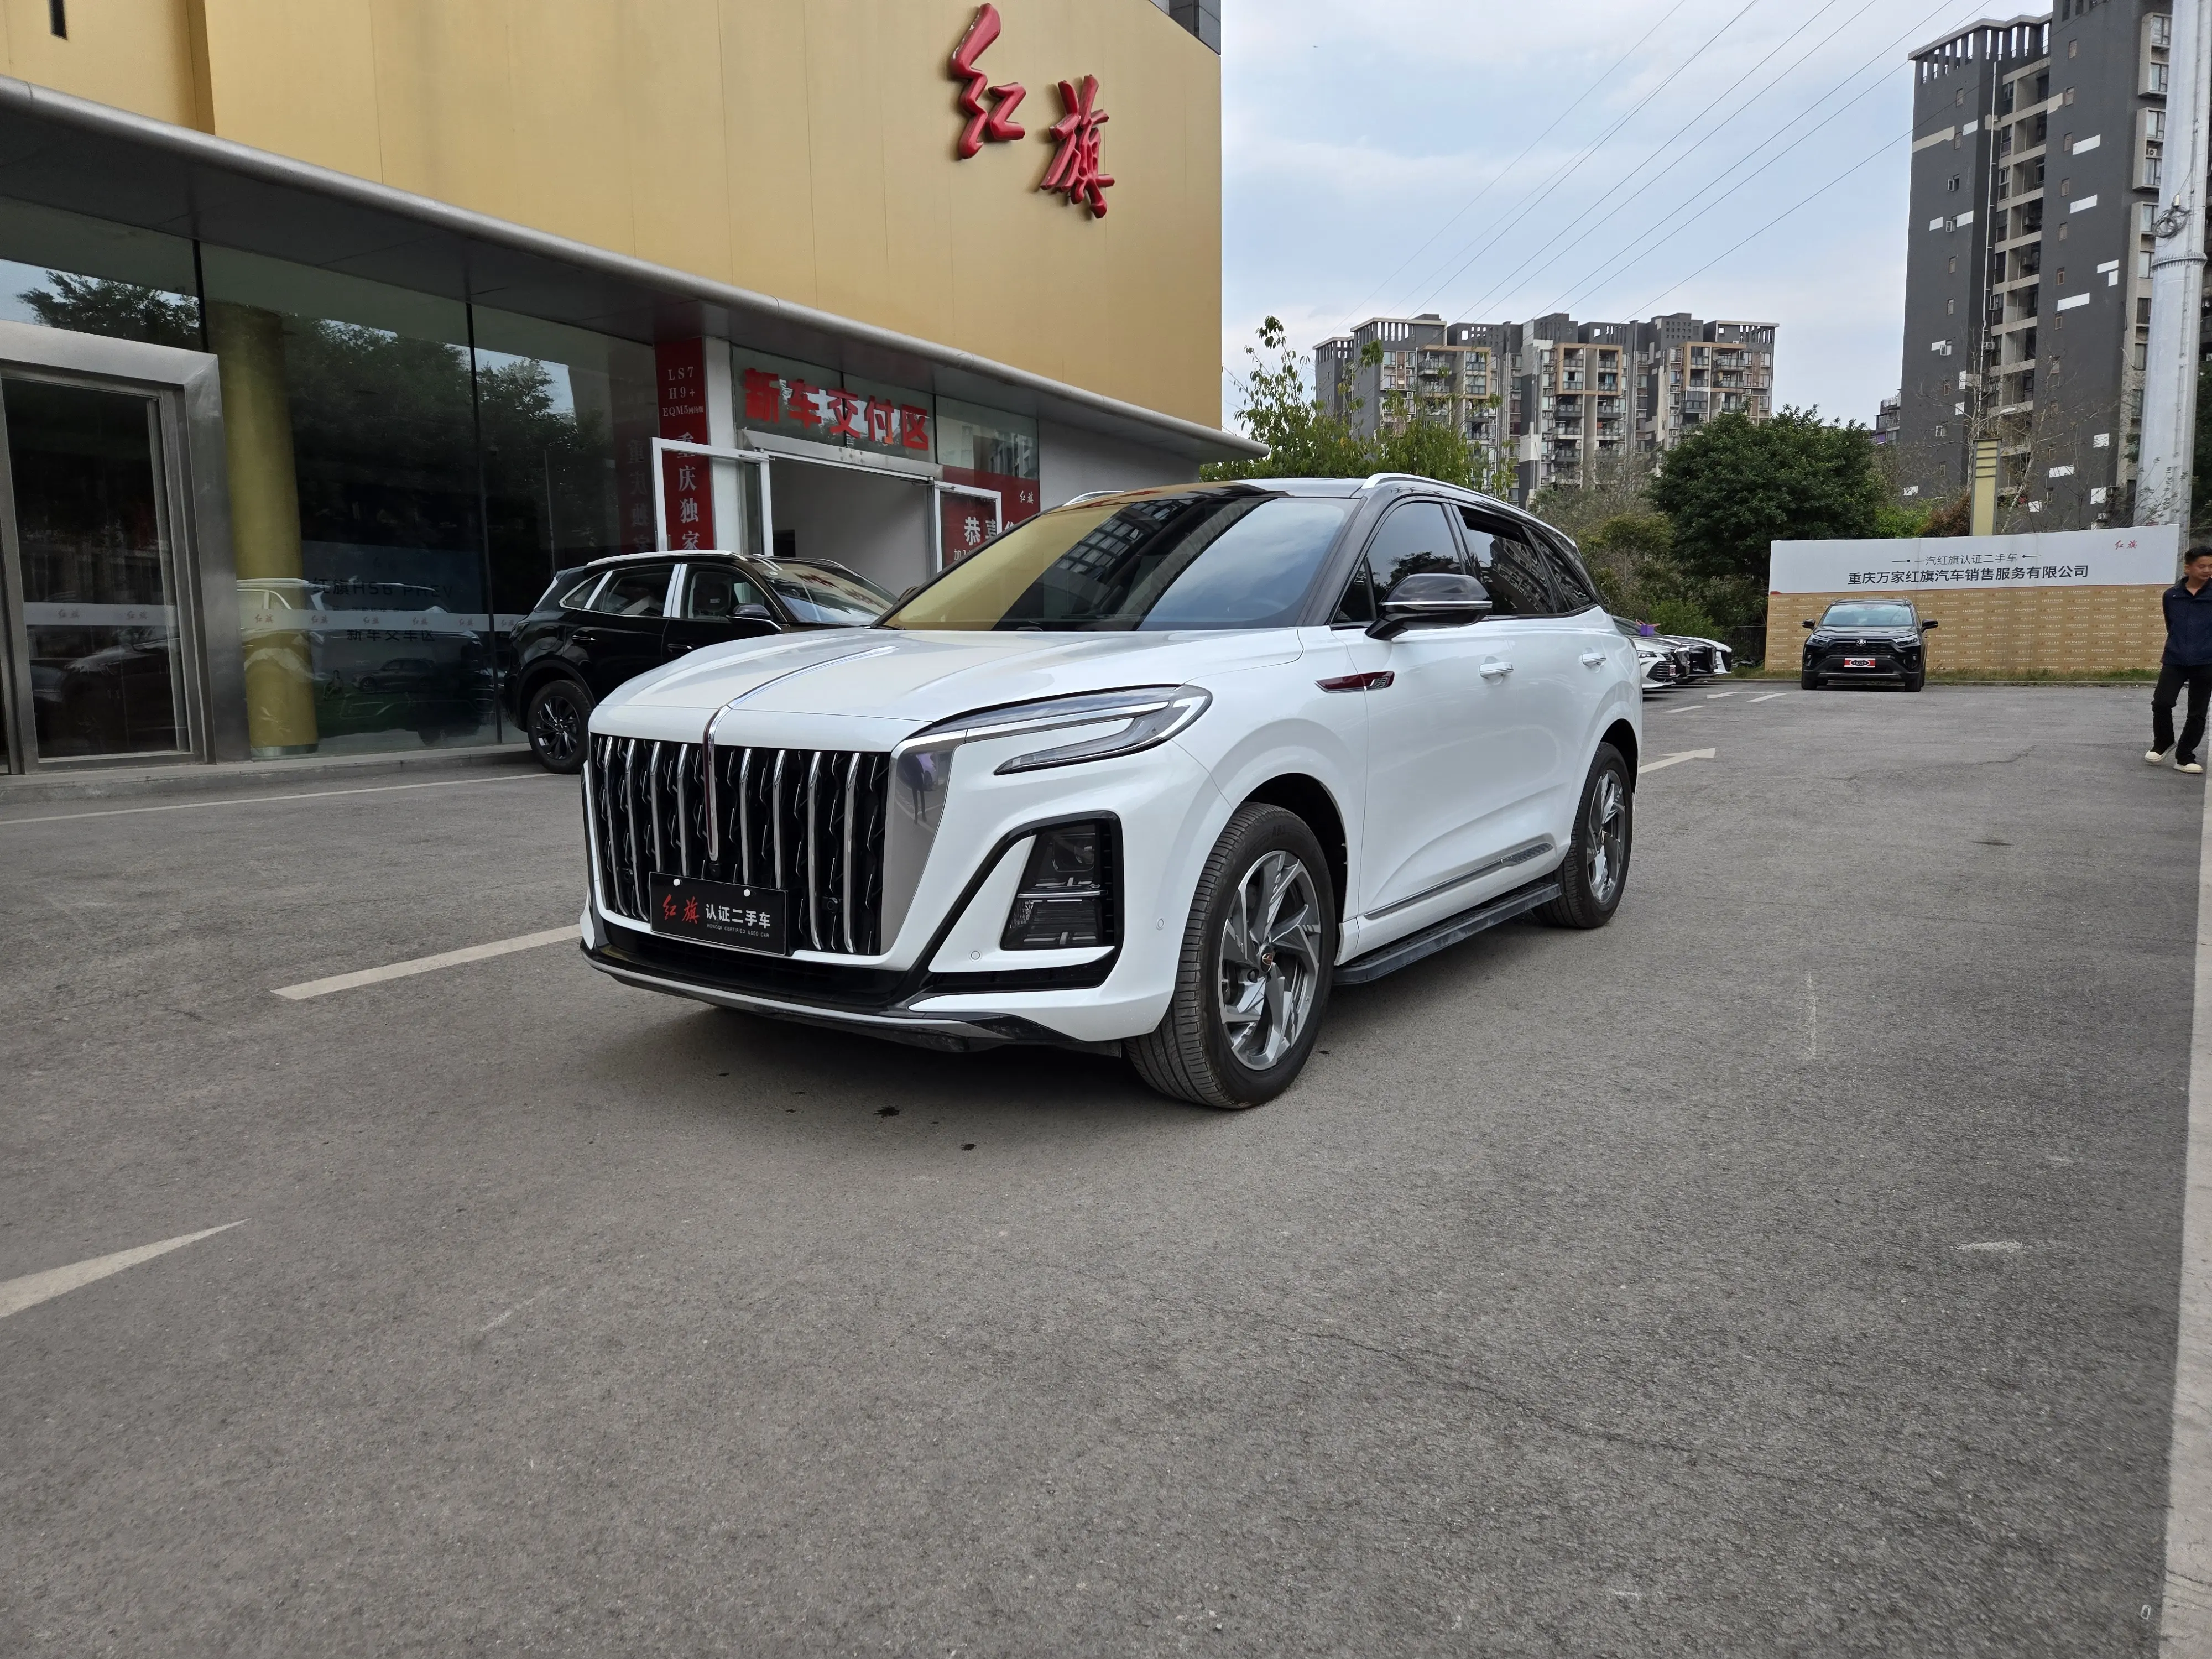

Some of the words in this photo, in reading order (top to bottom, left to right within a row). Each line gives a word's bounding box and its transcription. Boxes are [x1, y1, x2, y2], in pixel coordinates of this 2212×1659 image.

[950, 3, 1115, 218] 红旗
[667, 366, 693, 380] LS7
[668, 386, 695, 399] H9+
[745, 368, 930, 451] 新车交付区
[2114, 539, 2137, 550] 红旗
[1914, 552, 2018, 566] 一汽红旗认证二手车
[1847, 564, 2089, 585] 重庆万家红旗汽车销售服务有限公司
[662, 893, 701, 925] 红旗
[705, 903, 771, 930] 认证二手车
[724, 925, 746, 935] CERTIFIED
[747, 928, 759, 937] USED
